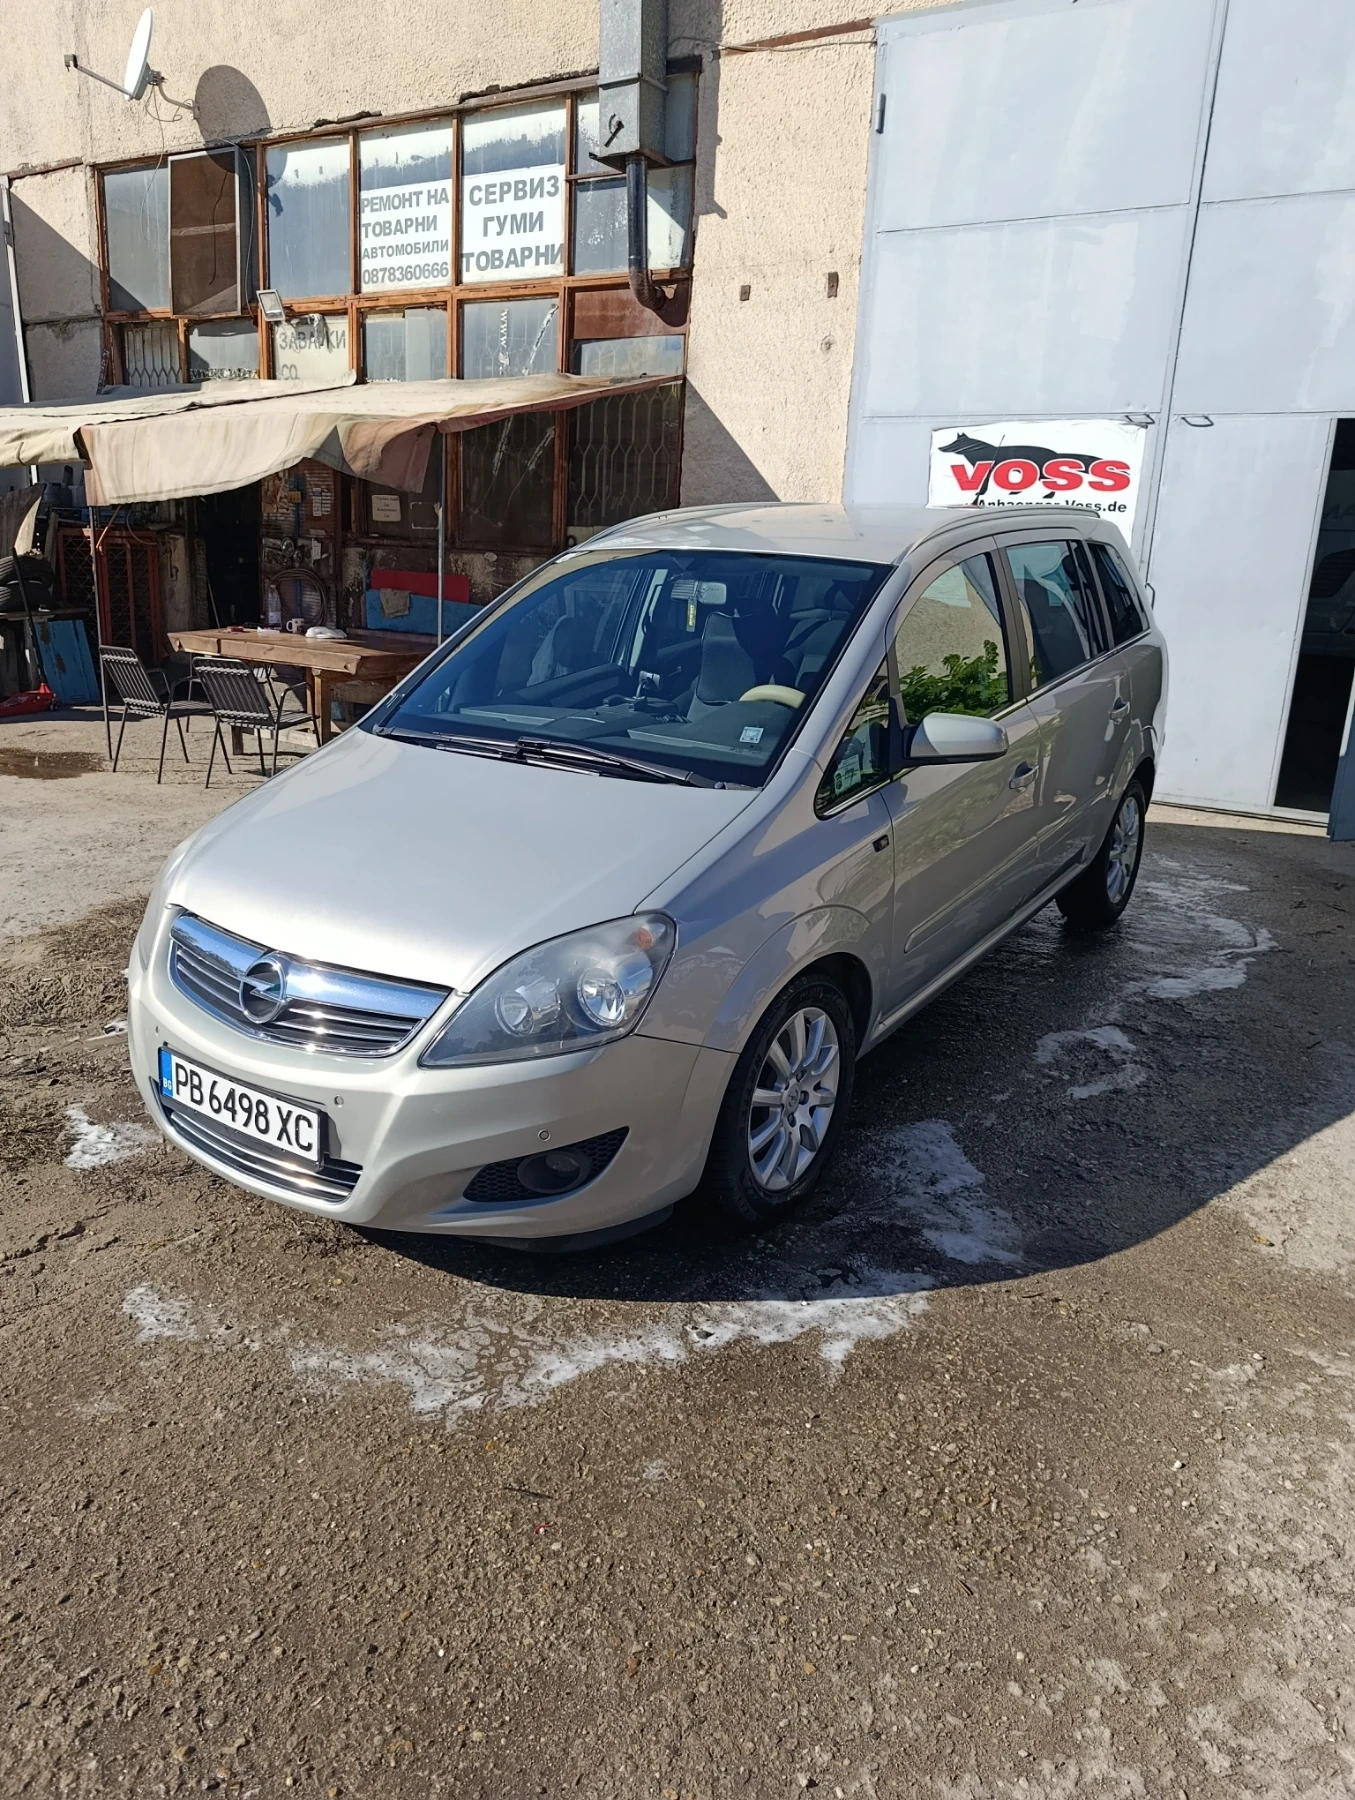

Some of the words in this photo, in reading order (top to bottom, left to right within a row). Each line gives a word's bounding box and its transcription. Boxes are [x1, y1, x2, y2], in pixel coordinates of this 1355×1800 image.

[361, 190, 423, 214] РЕМОНТ
[427, 187, 450, 206] НА
[469, 175, 560, 207] СЕРВИЗ
[361, 214, 438, 239] ТОВАРНИ
[483, 210, 544, 237] ГУМИ
[362, 239, 449, 260] АВТОМОБИЛИ
[462, 242, 564, 273] ТОВАРНИ
[362, 261, 449, 285] 0878360666
[279, 330, 346, 350] ЗАВАКИ
[950, 458, 1131, 492] VOSS
[163, 1077, 172, 1091] BG
[209, 1080, 270, 1135] 6498
[276, 1105, 313, 1152] XC
